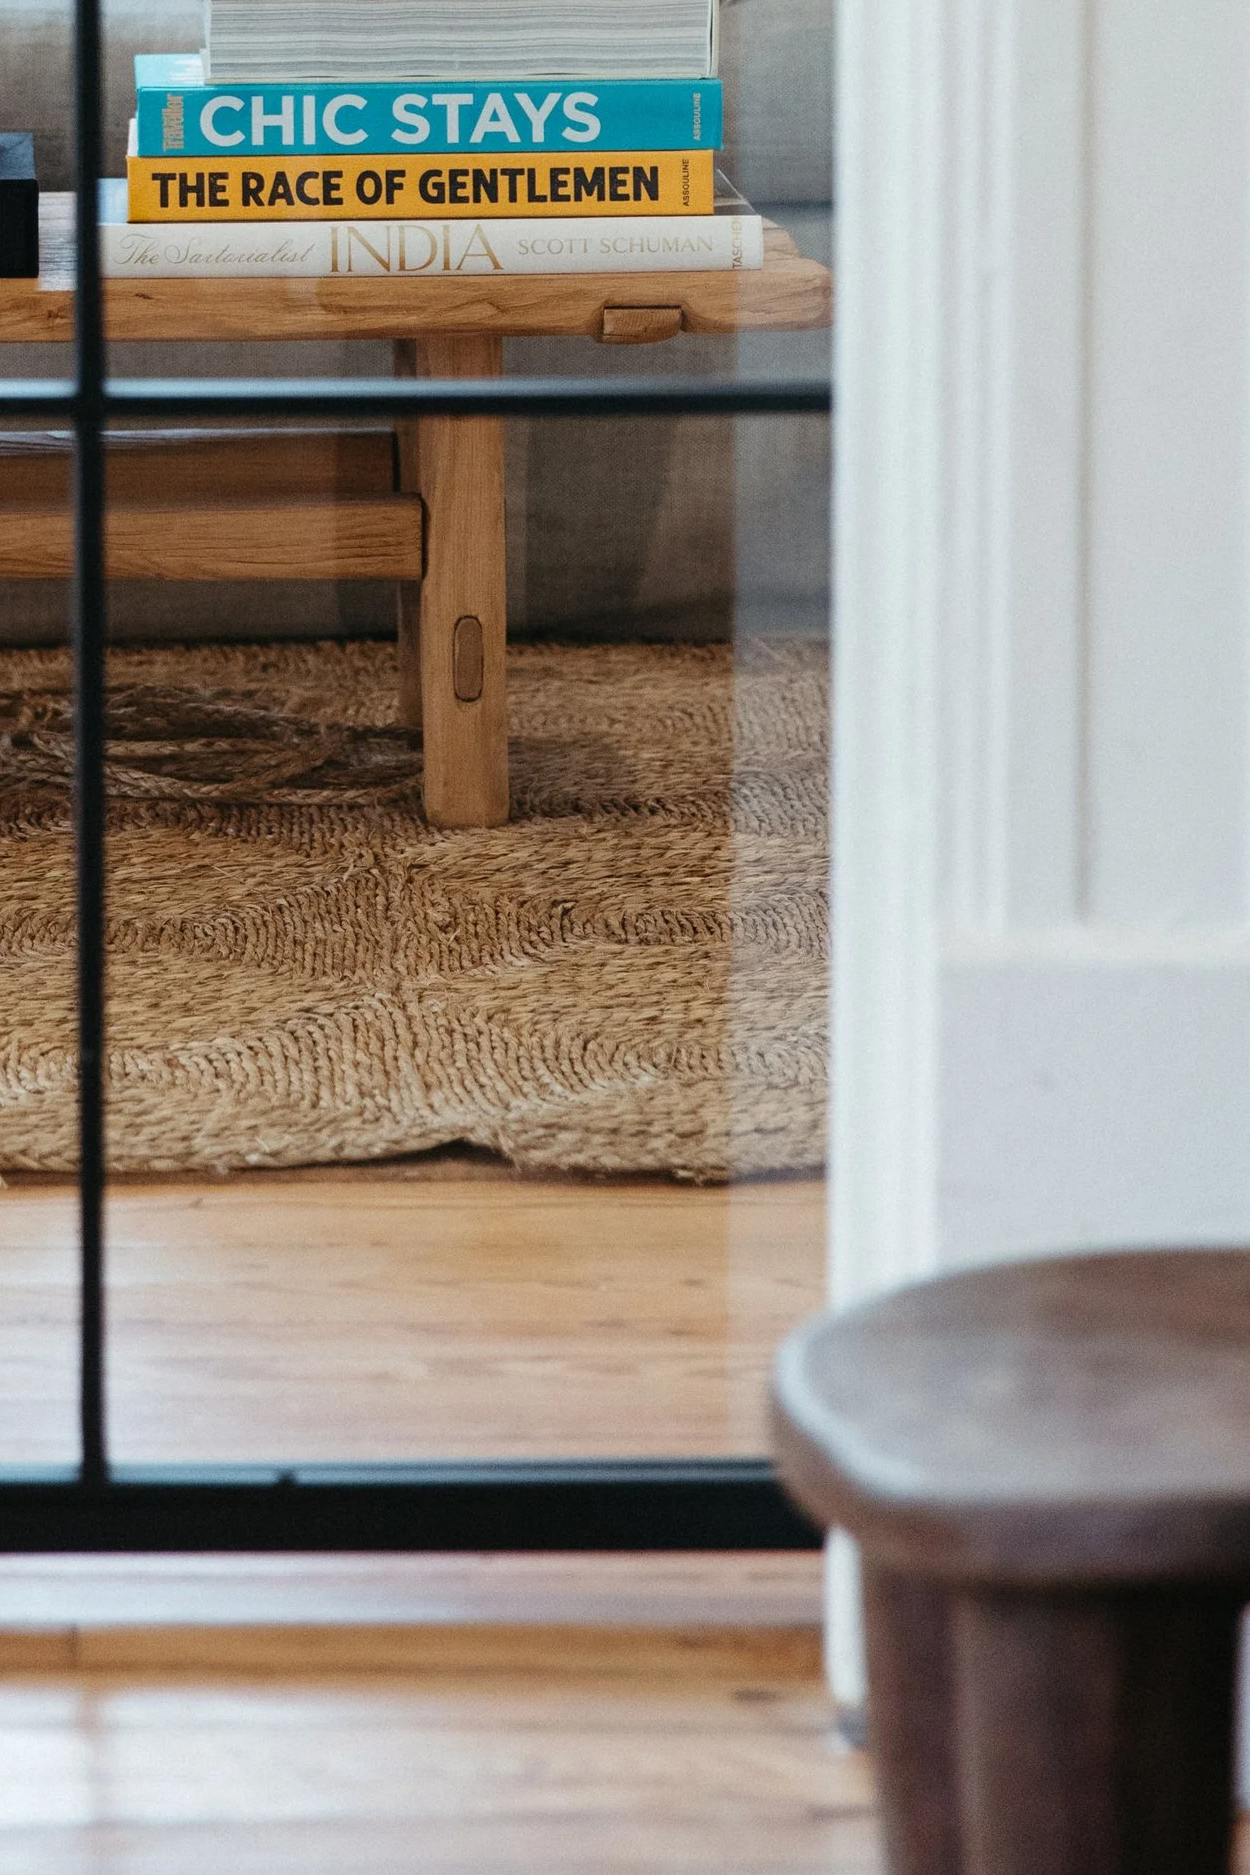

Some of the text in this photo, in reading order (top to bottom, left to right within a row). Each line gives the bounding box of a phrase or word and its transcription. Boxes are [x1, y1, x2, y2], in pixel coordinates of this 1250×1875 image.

[199, 91, 601, 149] CHIC STAYS
[693, 92, 701, 141] ASSOULINE
[151, 166, 660, 209] THE RACE OF GENTLEMEN
[682, 158, 690, 207] ASSOULINE
[113, 236, 316, 267] The Sartorialist
[328, 224, 505, 274] INDIA
[517, 234, 715, 257] SCOTT SCHUMAN
